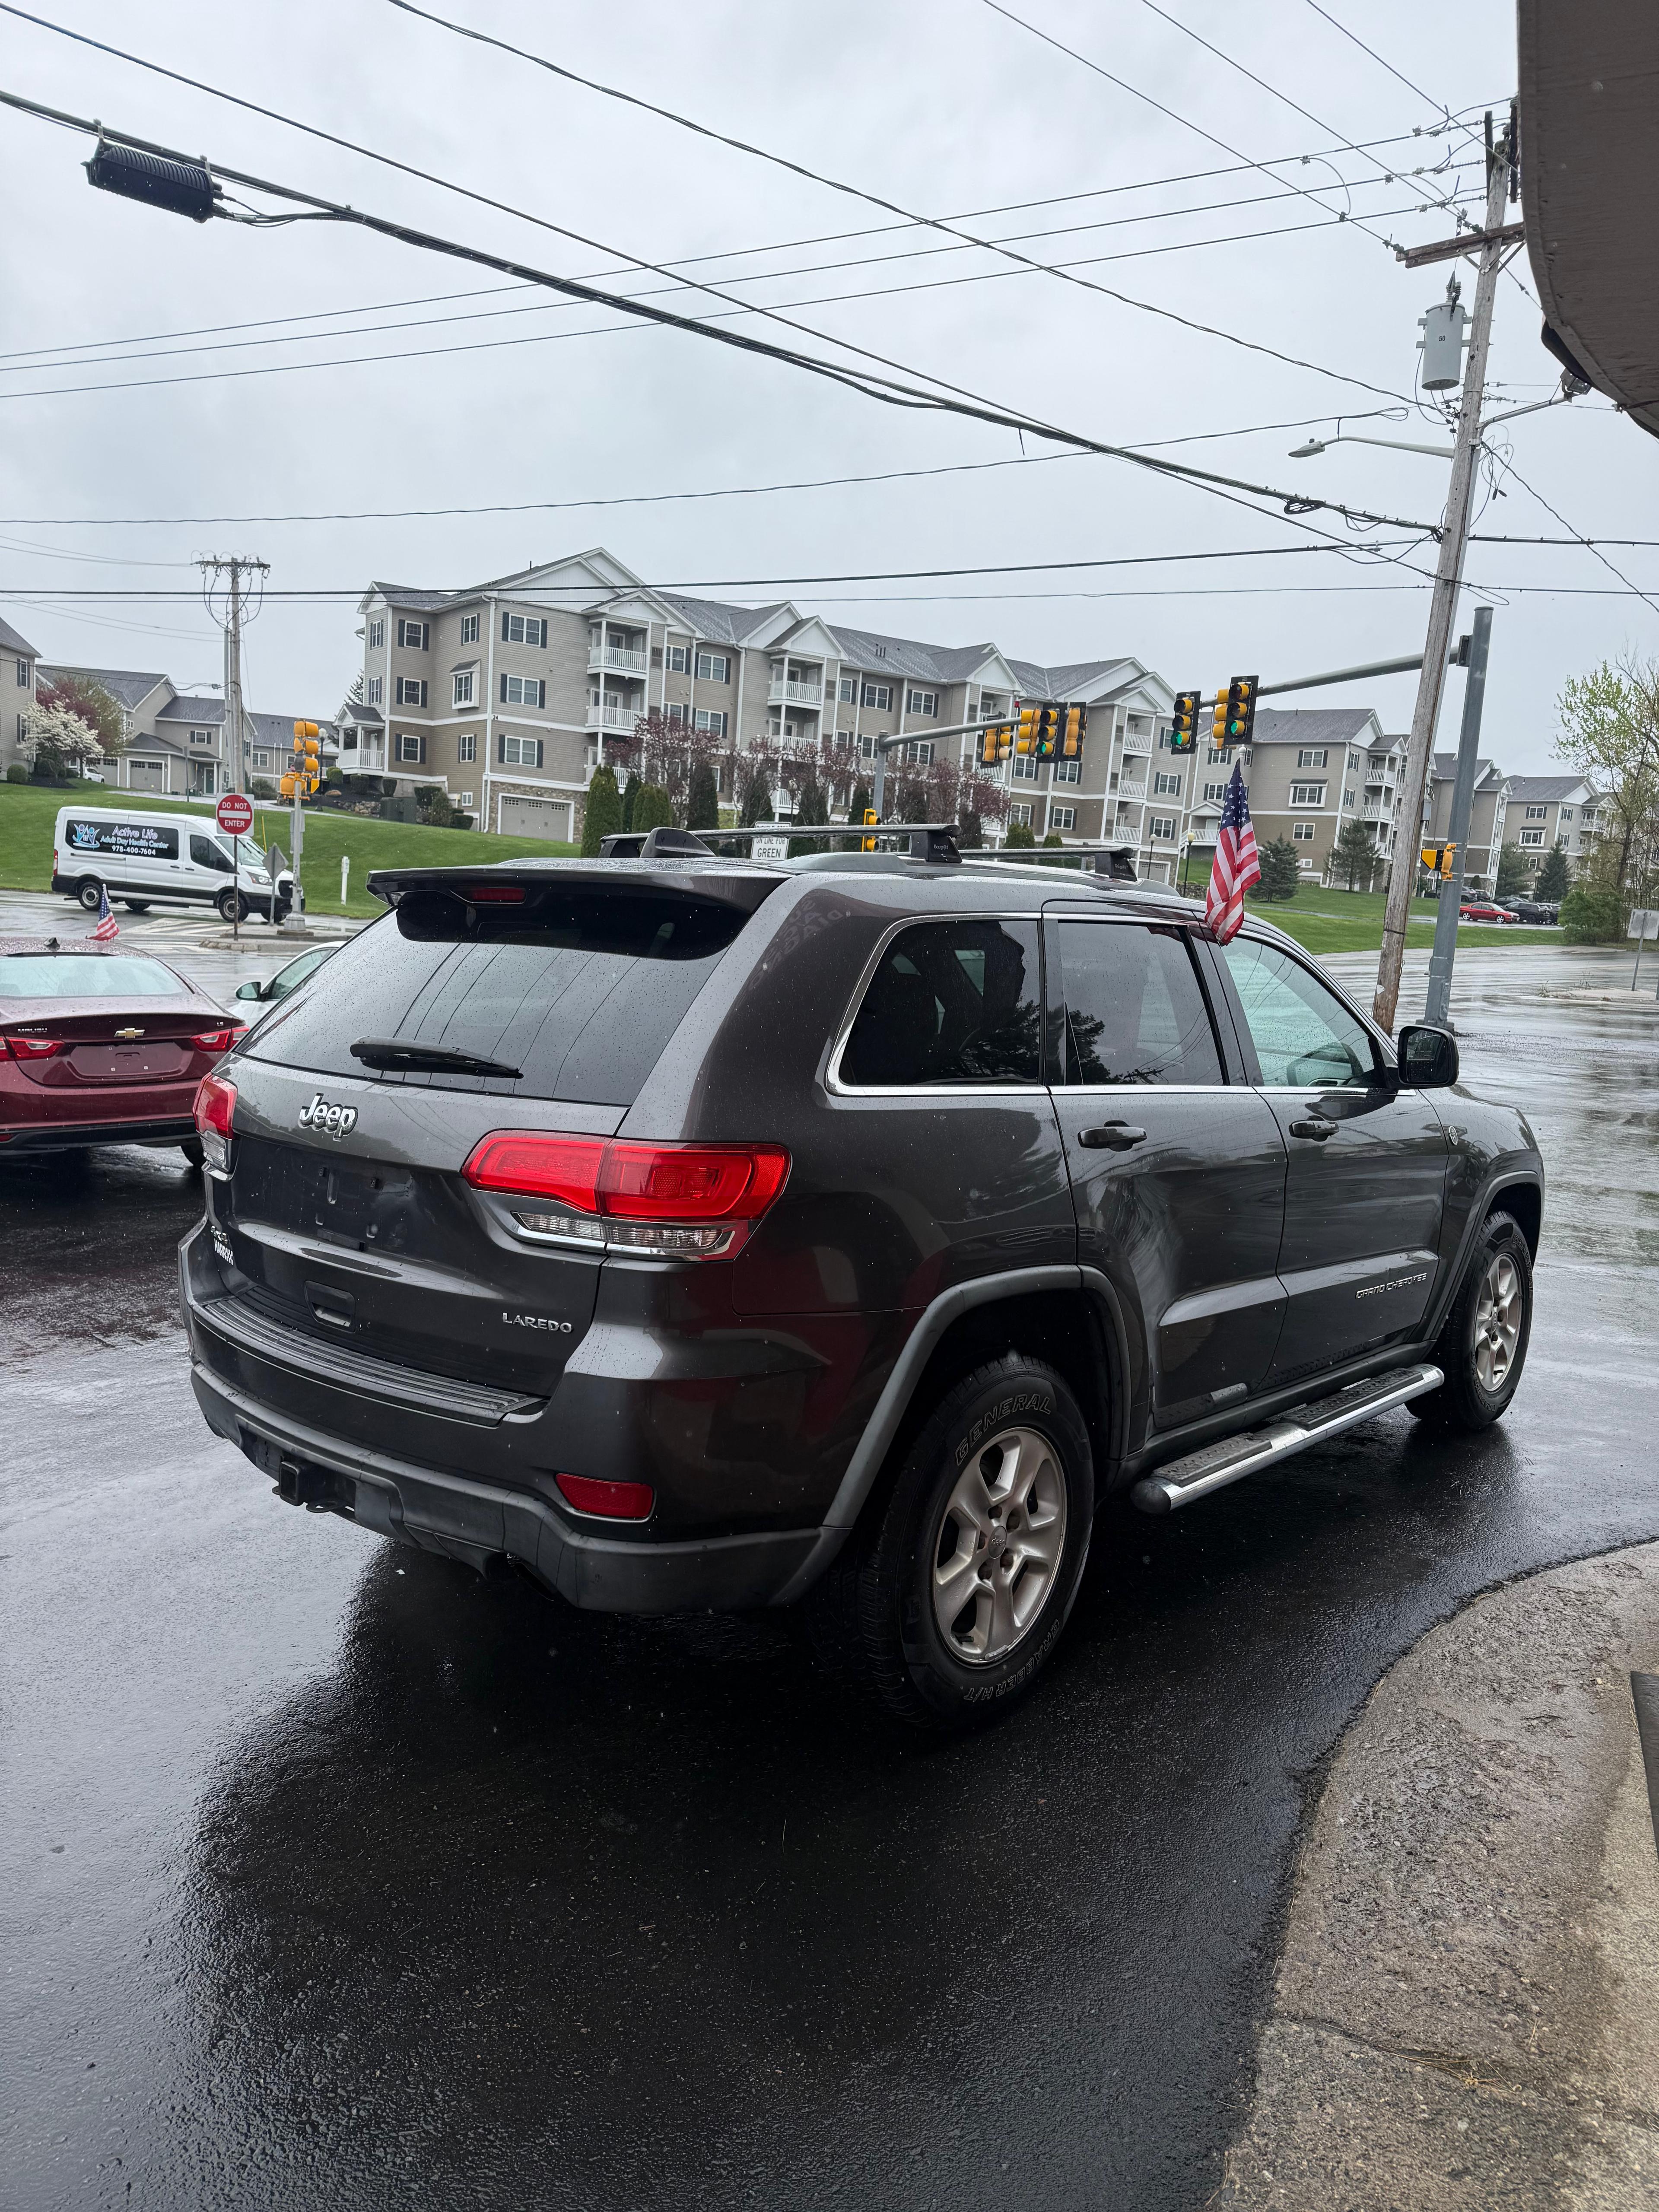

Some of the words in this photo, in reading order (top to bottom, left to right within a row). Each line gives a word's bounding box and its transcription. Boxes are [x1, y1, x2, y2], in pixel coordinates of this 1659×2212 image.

[224, 820, 245, 828] ENTER
[111, 826, 140, 838] Active
[141, 828, 158, 840] Life
[100, 835, 116, 843] Adult
[117, 837, 129, 846] Day
[129, 838, 148, 847] Health
[148, 840, 169, 849] Center
[111, 845, 156, 855] 978-400-7604
[757, 848, 781, 858] GREEN
[299, 1093, 359, 1141] Jeep
[1356, 1284, 1385, 1299] GRAND
[1386, 1273, 1427, 1290] CHEROKEE
[502, 1312, 573, 1333] LAREDO
[954, 1394, 1051, 1466] GENERAL
[995, 1619, 1059, 1697] GRABBER
[963, 1686, 993, 1703] H/T
